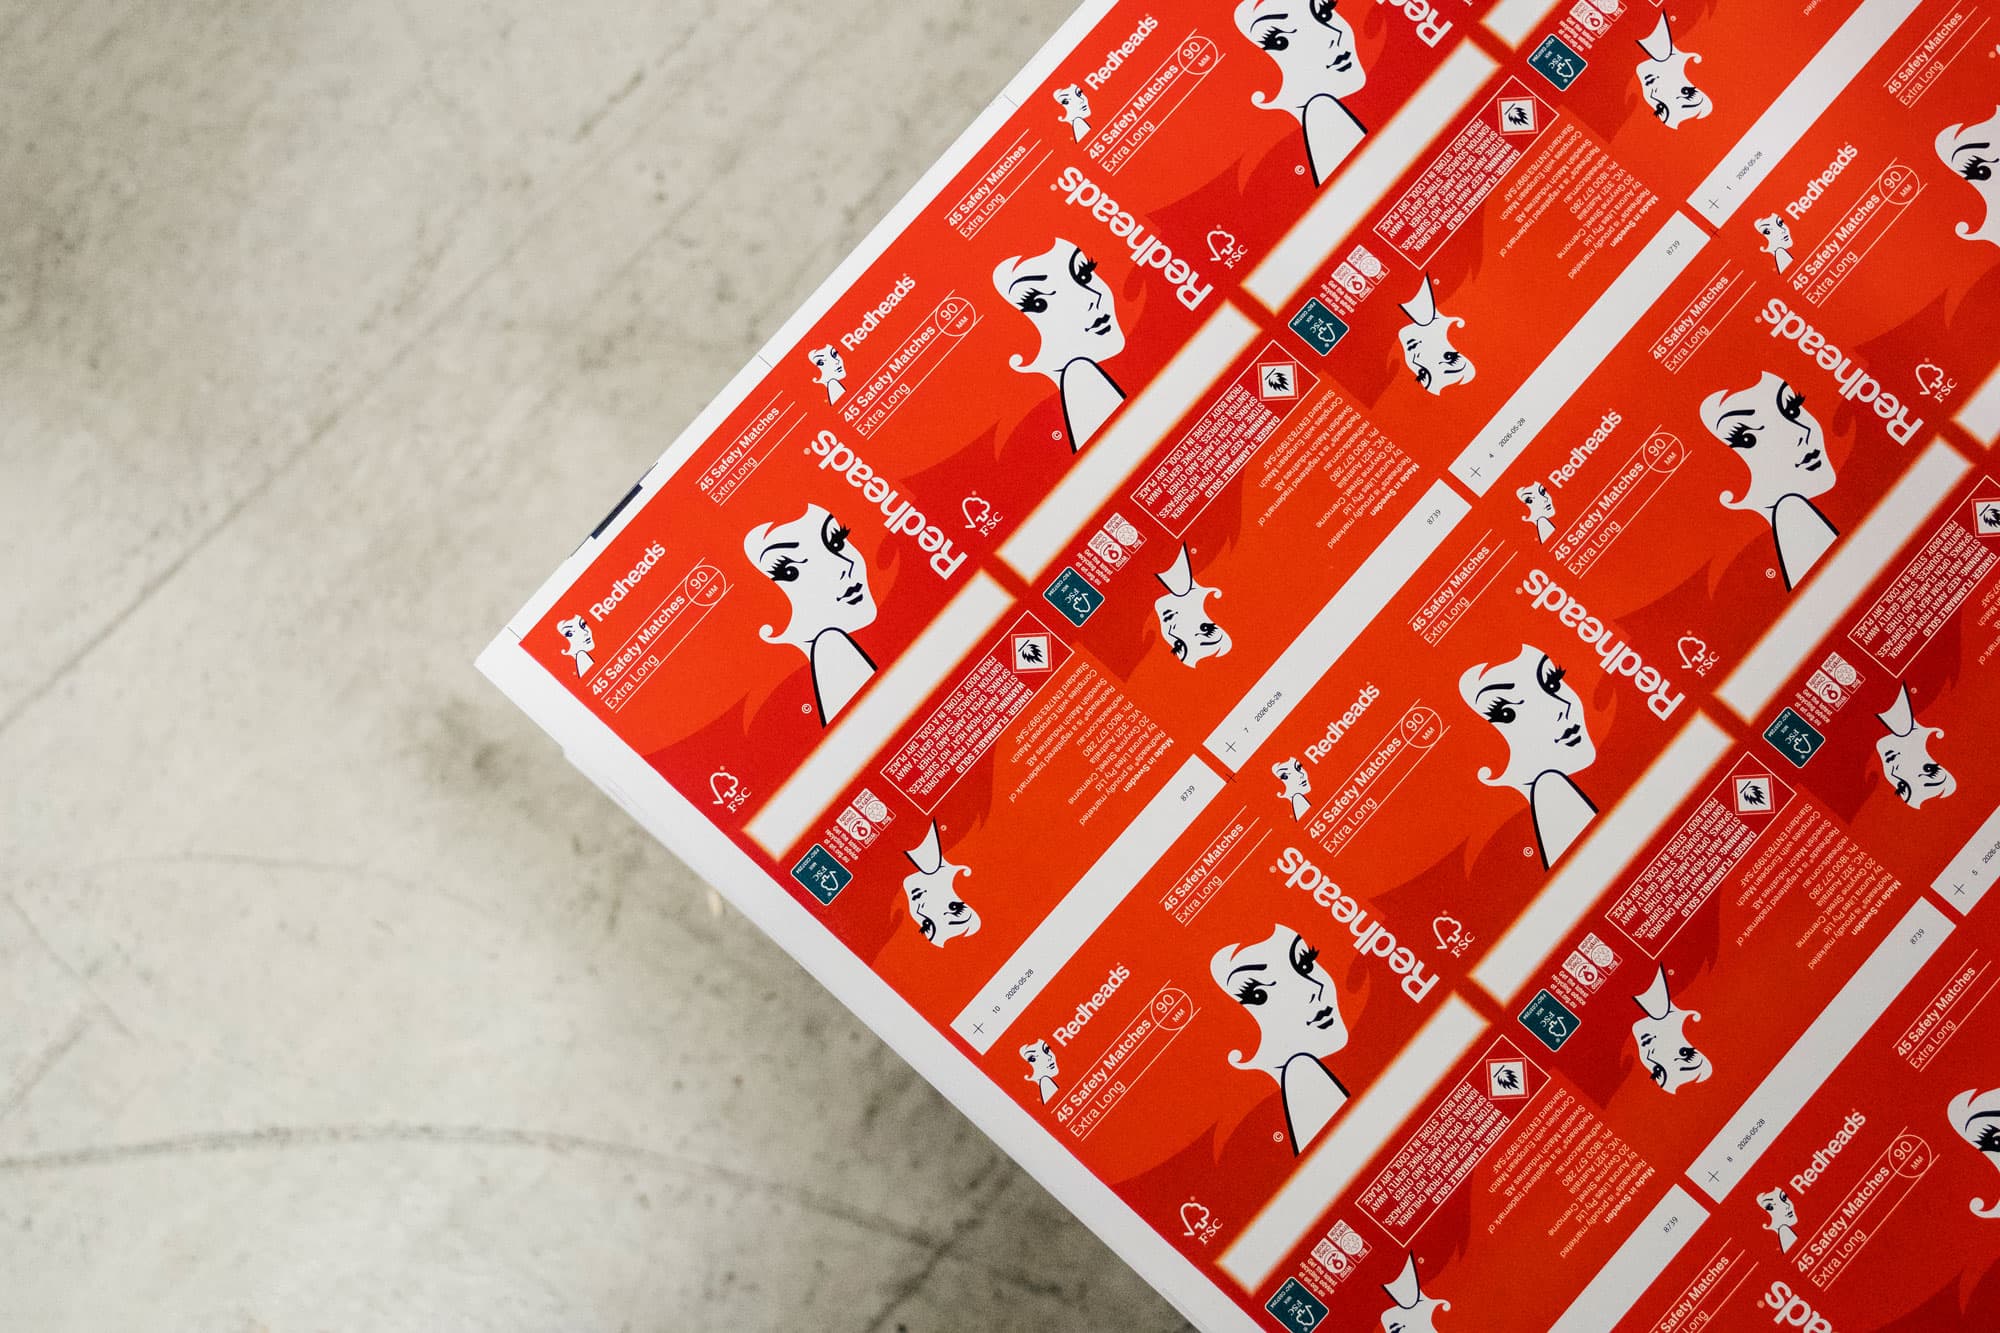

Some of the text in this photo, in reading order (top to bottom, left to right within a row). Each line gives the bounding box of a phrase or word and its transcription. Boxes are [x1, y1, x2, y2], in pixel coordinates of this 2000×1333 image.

[1181, 40, 1201, 60] 90
[1197, 53, 1211, 68] MM
[1887, 12, 1963, 95] 45 Safety Matches
[1898, 59, 1945, 106] Extra Long
[1088, 64, 1179, 160] 45 Safety Matches
[1100, 119, 1155, 173] Extra Long
[948, 145, 1027, 227] 45 Safety Matches
[1883, 170, 1902, 189] 90
[1898, 183, 1913, 198] MM
[958, 192, 1006, 239] Extra Long
[1223, 243, 1249, 270] FSC
[1792, 193, 1881, 291] 45 Safety Matches
[1805, 250, 1859, 305] Extra Long
[939, 302, 959, 321] 90
[954, 315, 969, 329] MM
[1652, 275, 1729, 360] 45 Safety Matches
[1663, 324, 1710, 372] Extra Long
[843, 325, 936, 423] 45 Safety Matches
[1933, 377, 1958, 404] FSC
[855, 382, 911, 437] Extra Long
[699, 406, 780, 492] 45 Safety Matches
[1647, 437, 1667, 457] 90
[1663, 450, 1677, 466] MM
[709, 456, 759, 504] Extra Long
[978, 510, 1004, 537] FSC
[1553, 461, 1645, 561] 45 Safety Matches
[1566, 519, 1622, 576] Extra Long
[689, 570, 709, 590] 90
[704, 584, 719, 599] MM
[1411, 545, 1490, 632] 45 Safety Matches
[1422, 595, 1471, 644] Extra Long
[591, 594, 686, 696] 45 Safety Matches
[1694, 650, 1720, 677] FSC
[603, 653, 660, 710] Extra Long
[1404, 712, 1425, 732] 90
[1421, 725, 1435, 741] MM
[726, 786, 752, 814] FSC
[1308, 736, 1402, 839] 45 Safety Matches
[1322, 796, 1378, 854] Extra Long
[1163, 823, 1244, 912] 45 Safety Matches
[1174, 874, 1223, 924] Extra Long
[1450, 931, 1476, 959] FSC
[1155, 993, 1175, 1014] 90
[1171, 1007, 1186, 1023] MM
[1896, 966, 1976, 1057] 45 Safety Matches
[1908, 1019, 1957, 1070] Extra Long
[1056, 1019, 1152, 1123] 45 Safety Matches
[1069, 1079, 1127, 1138] Extra Long
[1892, 1140, 1913, 1161] 90
[1909, 1154, 1924, 1170] MM
[1197, 1217, 1223, 1245] FSC
[1796, 1252, 1815, 1273] 45
[1809, 1215, 1848, 1256] Safety
[1841, 1166, 1890, 1219] Matches
[1810, 1228, 1868, 1288] Extra Long
[1659, 1255, 1730, 1333] Safety Matches
